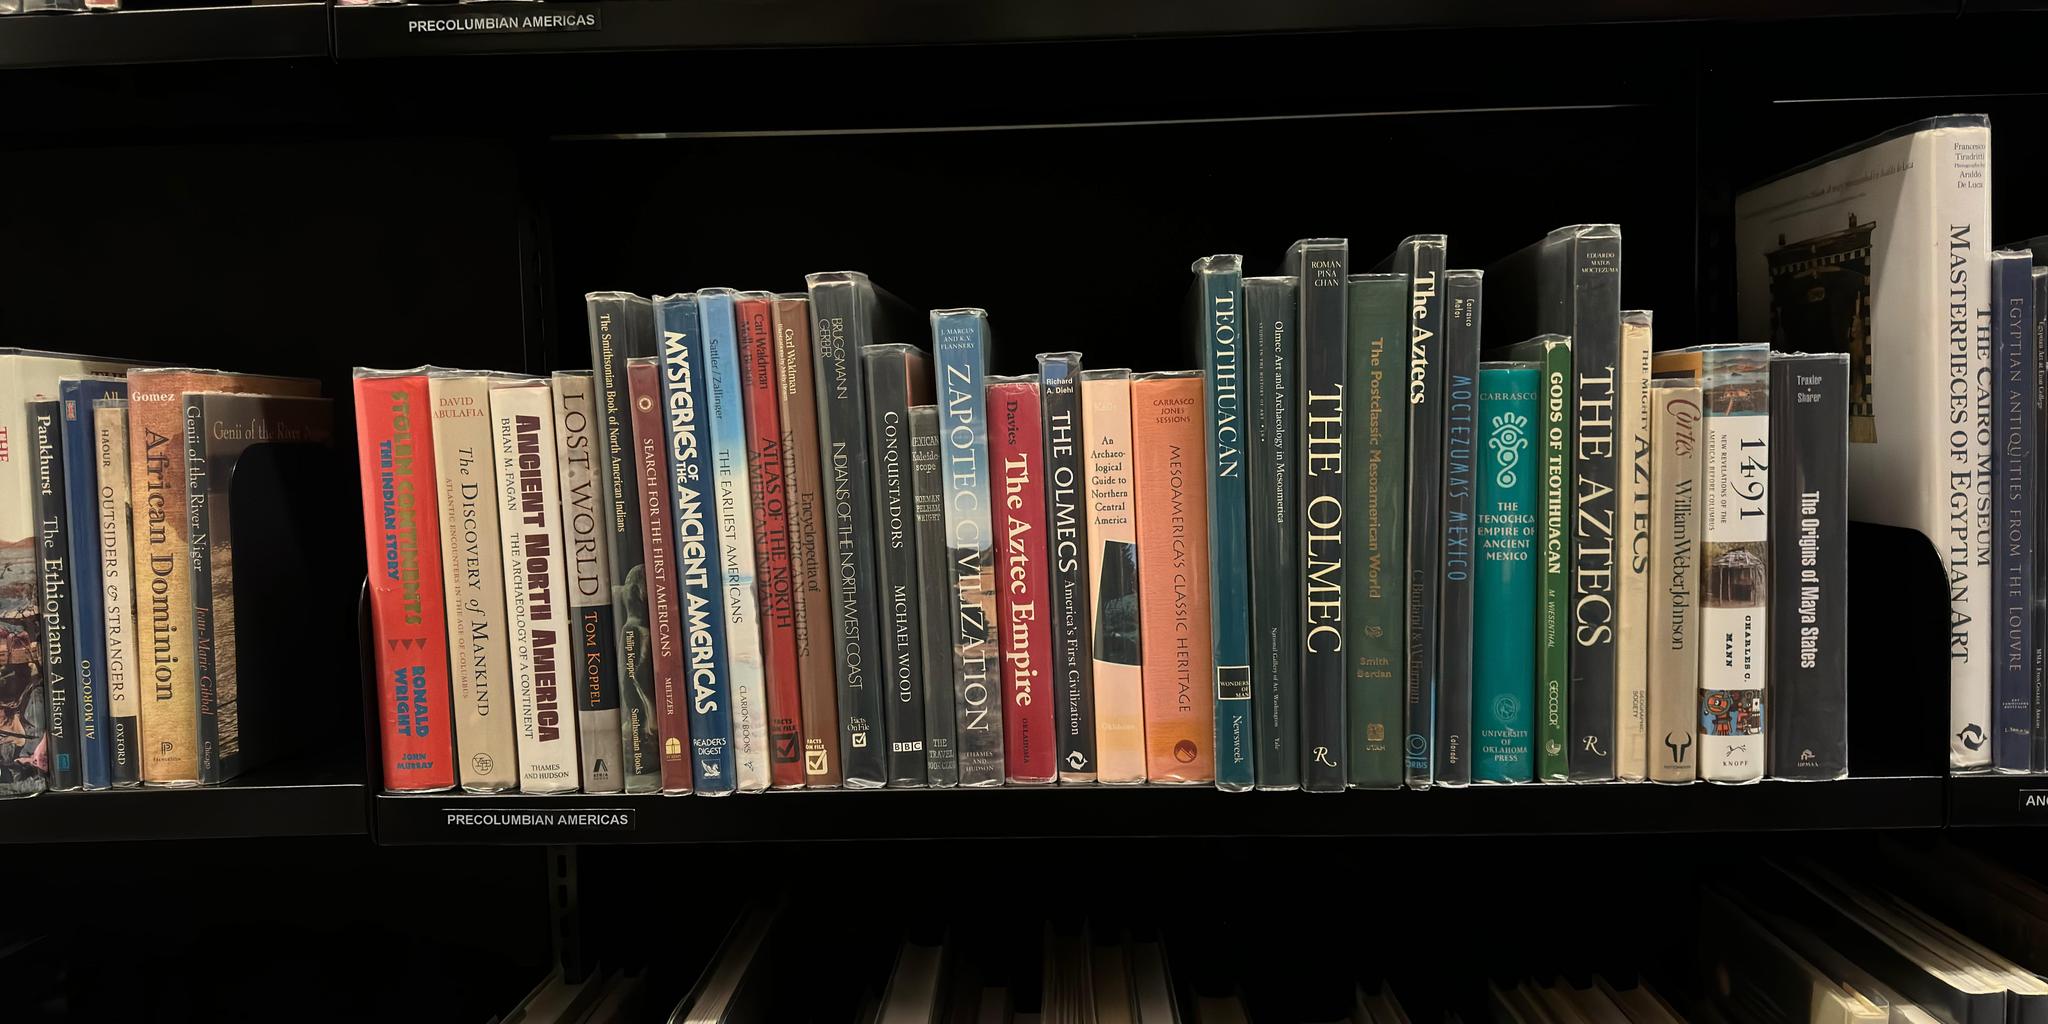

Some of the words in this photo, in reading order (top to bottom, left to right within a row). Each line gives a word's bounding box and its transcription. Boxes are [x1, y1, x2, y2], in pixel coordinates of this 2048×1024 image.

[408, 17, 518, 33] PRECOLUMBIAN
[523, 14, 595, 28] AMERICAS
[1413, 271, 1436, 320] The
[1274, 321, 1284, 353] Olmec
[1950, 223, 1971, 424] MASTERPIECES
[1976, 303, 1992, 361] THE
[2009, 297, 2023, 382] EGYPTIAN
[1275, 354, 1284, 370] Art
[1370, 337, 1384, 367] The
[1410, 326, 1434, 405] Aztecs
[132, 391, 175, 402] Gomez
[664, 331, 698, 461] MYSTERIES
[1046, 377, 1073, 385] Richard
[1046, 386, 1054, 394] A.
[1055, 386, 1074, 394] Diehl
[1153, 398, 1195, 406] CARRASCO
[1275, 372, 1285, 390] and
[1480, 392, 1538, 401] CARRASCO
[1549, 371, 1563, 423] GODS
[1641, 378, 1649, 432] MIGHTY
[1976, 366, 1991, 446] CAIRO
[186, 406, 200, 446] Genii
[563, 392, 589, 470] LOST
[1006, 401, 1020, 445] Davies
[1156, 416, 1191, 424] SESSIONS
[1161, 407, 1185, 415] JONES
[1274, 392, 1285, 449] Archaeology
[1308, 383, 1343, 477] THE
[1369, 371, 1383, 445] Postclassic
[1579, 366, 1616, 461] THE
[36, 415, 52, 496] Pankhurst
[188, 449, 205, 461] of
[380, 440, 392, 468] THE
[391, 391, 412, 476] STOLEN
[501, 418, 512, 453] BRIAN
[947, 364, 978, 512] ZAPOTEC
[1051, 410, 1072, 459] THE
[1091, 449, 1125, 458] Archaeo-
[1102, 436, 1114, 445] An
[1276, 451, 1284, 461] in
[1449, 375, 1472, 498] MOCTEZUMA'S
[1549, 427, 1563, 450] OF
[1950, 430, 1969, 465] OF
[2007, 390, 2022, 501] ANTIQUITIES
[144, 427, 170, 544] African
[189, 464, 204, 489] the
[459, 447, 473, 476] The
[504, 456, 513, 472] M.
[515, 414, 545, 527] ANCIENT
[643, 438, 657, 490] SEARCH
[676, 461, 688, 484] THE
[687, 463, 699, 481] OF
[719, 449, 730, 476] THE
[762, 437, 781, 494] ATLAS
[884, 411, 904, 549] CONQUISTADORS
[1004, 452, 1030, 511] The
[1092, 476, 1117, 486] Guide
[1118, 477, 1127, 485] to
[1095, 462, 1122, 474] logical
[1730, 438, 1768, 520] 1491
[190, 494, 205, 528] River
[381, 471, 397, 530] INDIAN
[506, 473, 517, 511] FAGAN
[649, 493, 660, 515] FOR
[721, 479, 736, 540] EARLIEST
[767, 499, 784, 520] OF
[1091, 489, 1128, 498] Northern
[1095, 502, 1125, 511] Central
[1168, 445, 1186, 569] MESOAMERICA'S
[1277, 463, 1286, 523] Mesoamerica
[1368, 449, 1383, 551] Mesoamerican
[1497, 502, 1519, 511] THE
[1548, 454, 1562, 574] TEOTIHUACAN
[1632, 433, 1650, 575] AZTECS
[1801, 490, 1820, 515] The
[1977, 454, 1991, 567] MUSEUM
[43, 516, 58, 549] The
[101, 486, 118, 578] OUTSIDERS
[461, 482, 481, 590] DISCOVERY
[510, 532, 520, 556] THE
[569, 479, 599, 596] WORLD
[651, 518, 663, 545] THE
[678, 484, 708, 589] ANCIENT
[770, 525, 786, 562] THE
[1054, 466, 1078, 573] OLMECS
[1094, 516, 1127, 525] America
[1478, 514, 1536, 524] TENOCHCA
[1478, 526, 1519, 536] EMPIRE
[1523, 526, 1536, 536] OF
[1483, 539, 1530, 549] ANCIENT
[1798, 518, 1820, 566] Origins
[1950, 469, 1972, 603] EGYPTIAN
[2009, 510, 2022, 557] FROM
[192, 534, 207, 572] Niger
[385, 534, 400, 581] STORY
[397, 480, 422, 625] CONTINENTS
[652, 548, 666, 582] FIRST
[1008, 514, 1032, 595] Aztec
[1447, 511, 1469, 581] MEXICO
[1486, 551, 1528, 561] MEXICO
[1576, 474, 1614, 647] AZTECS
[107, 584, 118, 601] &
[525, 533, 553, 621] NORTH
[726, 545, 743, 624] AMERICANS
[772, 566, 792, 629] NORTH
[1307, 495, 1342, 654] OLMEC
[1368, 553, 1381, 599] World
[1801, 569, 1819, 583] of
[2009, 566, 2022, 598] THE
[44, 557, 65, 665] Ethiopians
[464, 598, 486, 616] of
[512, 559, 527, 642] ARCHAEOLOGY
[656, 584, 671, 657] AMERICANS
[894, 585, 909, 651] MICHAEL
[1064, 579, 1078, 636] America's
[1173, 574, 1188, 632] CLASSIC
[1798, 586, 1819, 624] Maya
[151, 552, 179, 702] Dominion
[584, 610, 597, 647] TOM
[955, 521, 988, 732] CIVILIZATION
[1800, 627, 1819, 669] States
[1951, 607, 1972, 664] ART
[2009, 607, 2023, 672] LOUVRE
[108, 606, 125, 701] STRANGERS
[471, 620, 490, 717] MANKIND
[519, 645, 527, 660] OF
[520, 662, 528, 671] A
[686, 593, 718, 715] AMERICAS
[1006, 600, 1038, 707] Empire
[1067, 638, 1078, 668] First
[1176, 638, 1191, 713] HERITAGE
[1744, 672, 1751, 682] C.
[51, 672, 64, 685] A
[81, 659, 94, 721] MOROCCO
[394, 667, 412, 737] WRIGHT
[412, 666, 429, 738] RONALD
[531, 629, 560, 743] AMERICA
[587, 653, 600, 707] KOPPEL
[898, 653, 913, 703] WOOD
[1067, 670, 1081, 736] Civilization
[52, 689, 65, 739] History
[521, 674, 533, 739] CONTINENT
[85, 726, 95, 740] All
[893, 741, 922, 752] BBC
[447, 814, 554, 826] PRECOLUMBIAN
[557, 814, 629, 825] AMERICAS
